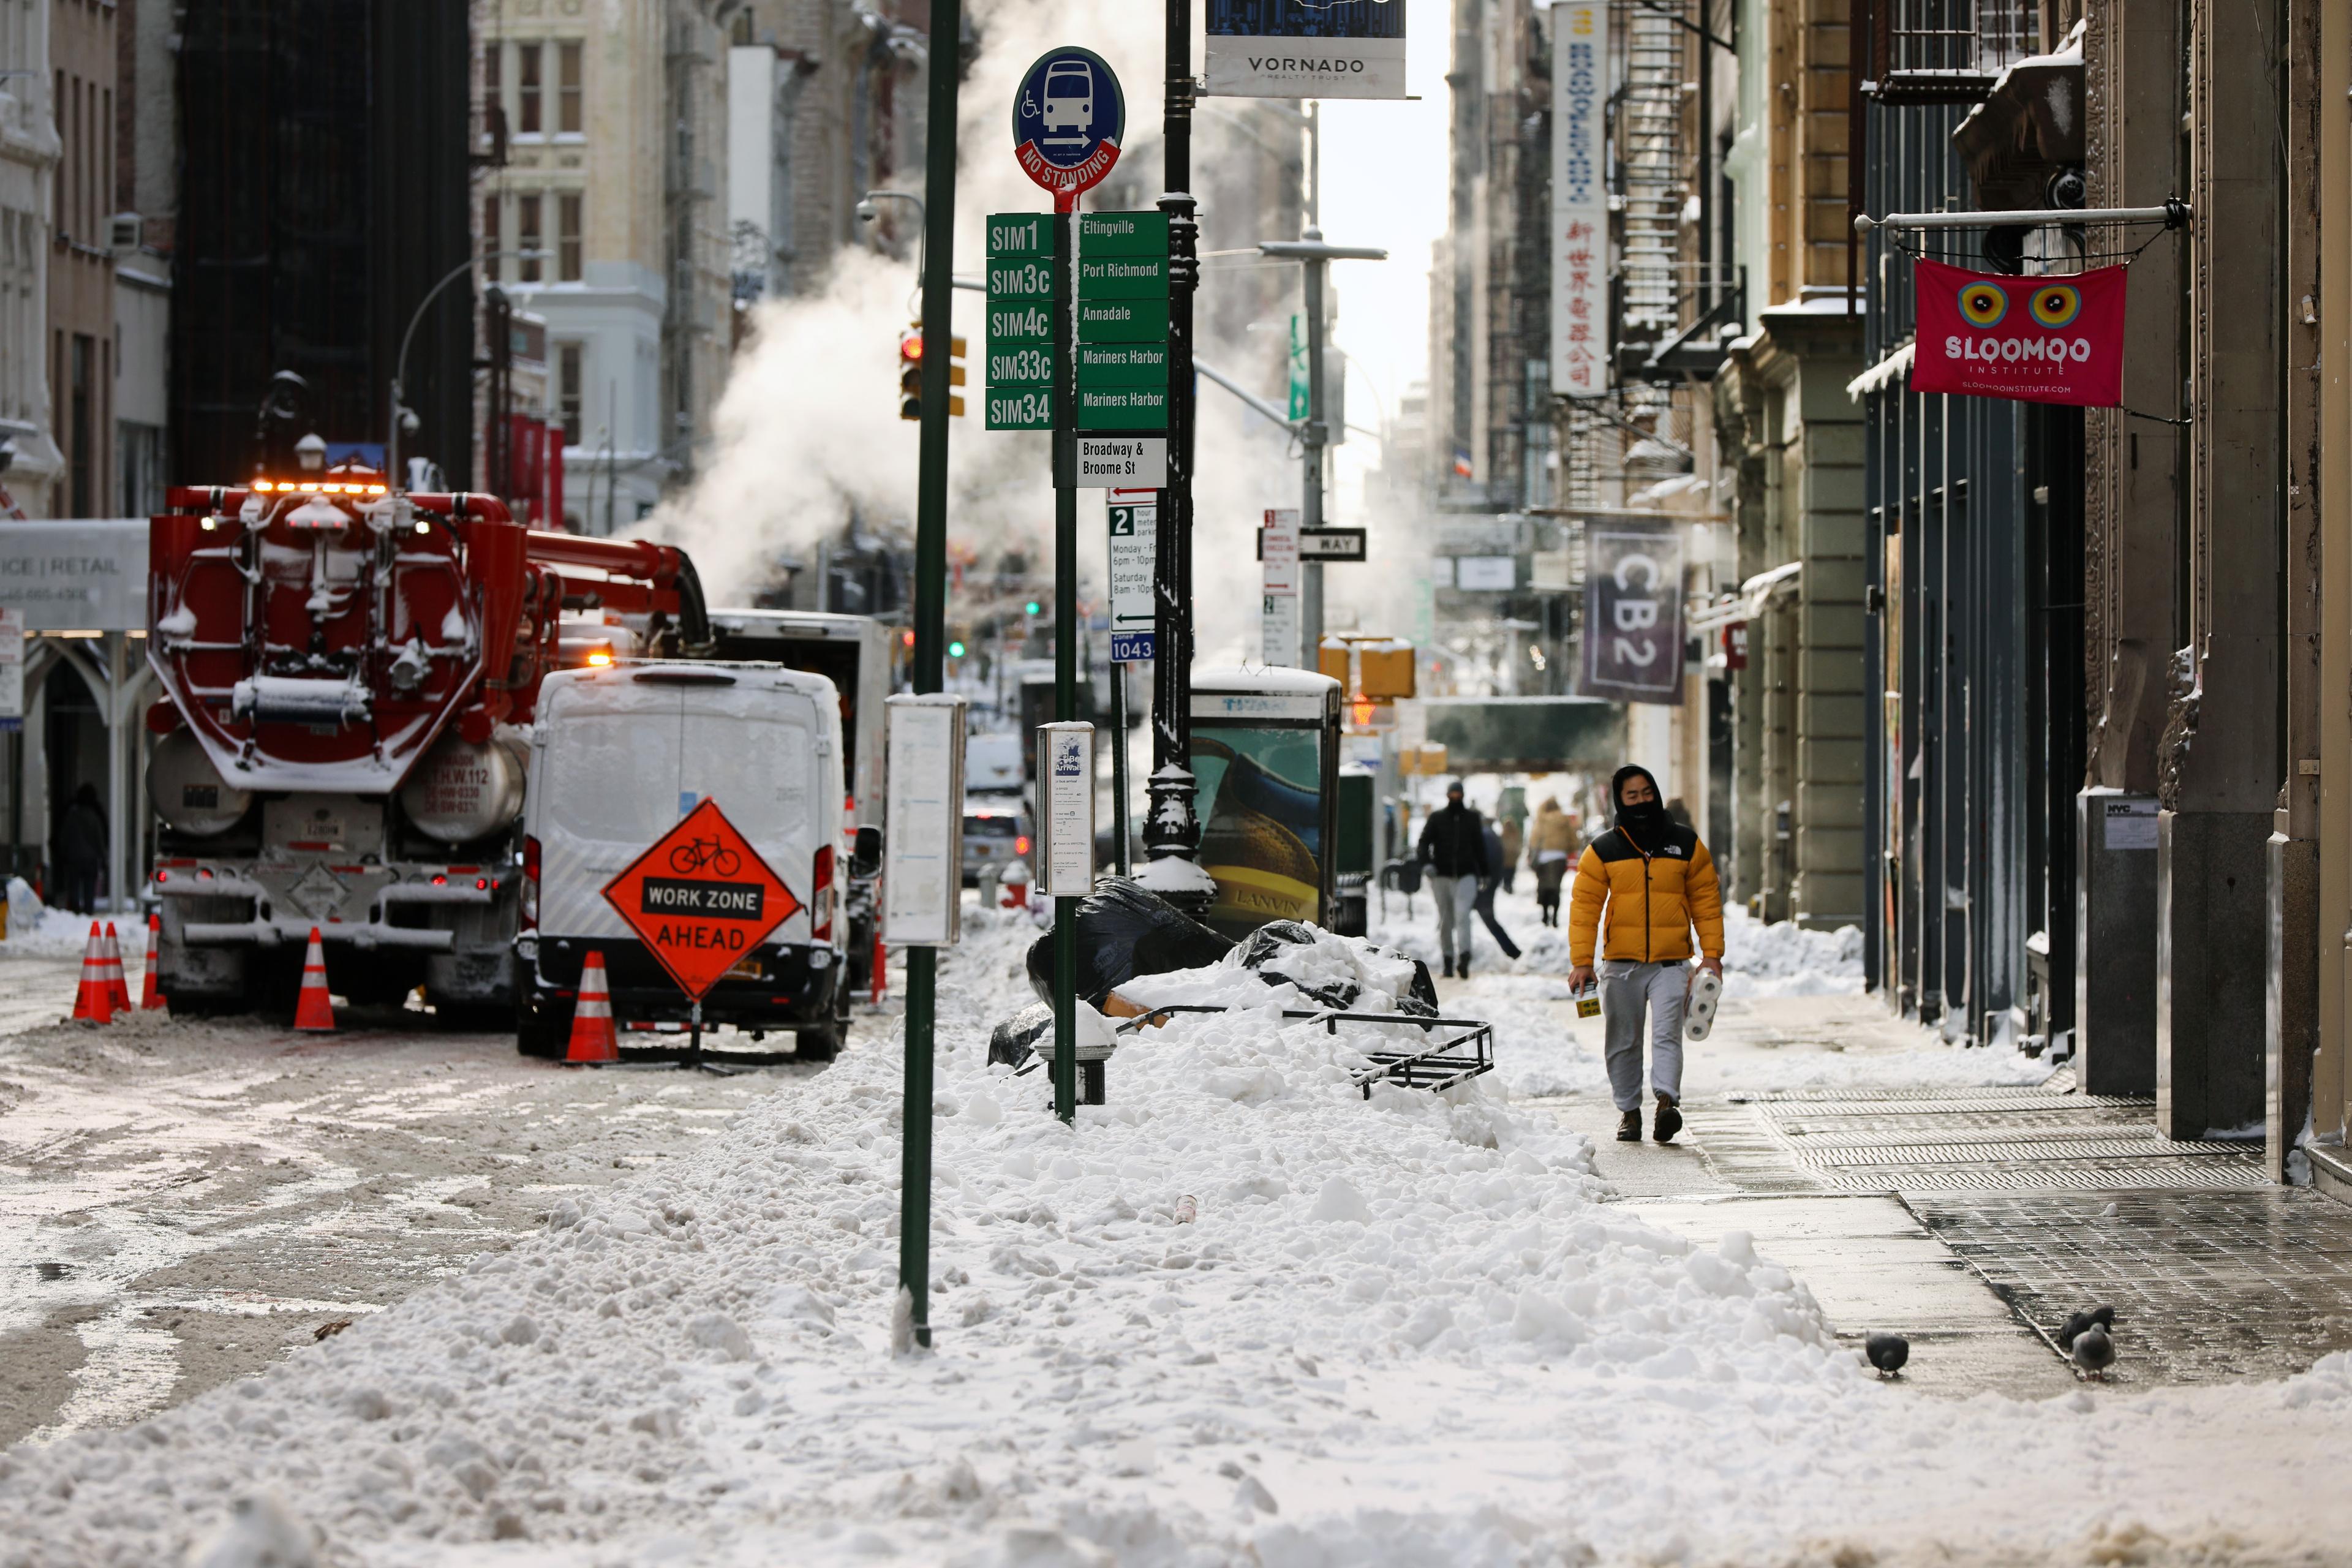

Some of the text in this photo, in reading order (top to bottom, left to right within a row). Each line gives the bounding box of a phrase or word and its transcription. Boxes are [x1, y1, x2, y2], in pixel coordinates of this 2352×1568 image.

[1248, 58, 1365, 73] VORNADO
[1023, 149, 1110, 187] NO STANDING
[992, 221, 1037, 251] SIM1
[1084, 220, 1134, 237] Eltingville
[1083, 263, 1158, 277] Port Richmond
[992, 264, 1050, 294] SIM3c
[1083, 307, 1131, 320] Annadale
[992, 307, 1048, 337] SIM4c
[1084, 350, 1163, 364] Mariners Harbor
[1945, 336, 2090, 368] SLOOMOO
[992, 350, 1051, 380] SIM33c
[1969, 366, 2064, 375] INSTITUTE
[1962, 382, 2071, 393] SLOOMOOINSTITUTE.COM
[1084, 393, 1164, 407] Mariners Harbor
[991, 394, 1050, 424] SIM34
[1084, 442, 1144, 458] Broadway &
[1084, 461, 1135, 474] Broome St
[1115, 509, 1128, 533] 2
[1113, 545, 1142, 554] Monday
[1321, 539, 1353, 549] WAY
[51, 557, 120, 576] RETAIL
[1114, 556, 1130, 567] 6pm
[1114, 573, 1147, 584] Saturday
[1114, 585, 1131, 594] 8am
[1613, 554, 1658, 668] CB2
[1114, 642, 1156, 658] 1043
[2108, 804, 2131, 813] NYC
[649, 886, 758, 911] WORK ZONE
[1234, 889, 1301, 914] LANVIN
[657, 924, 745, 951] AHEAD
